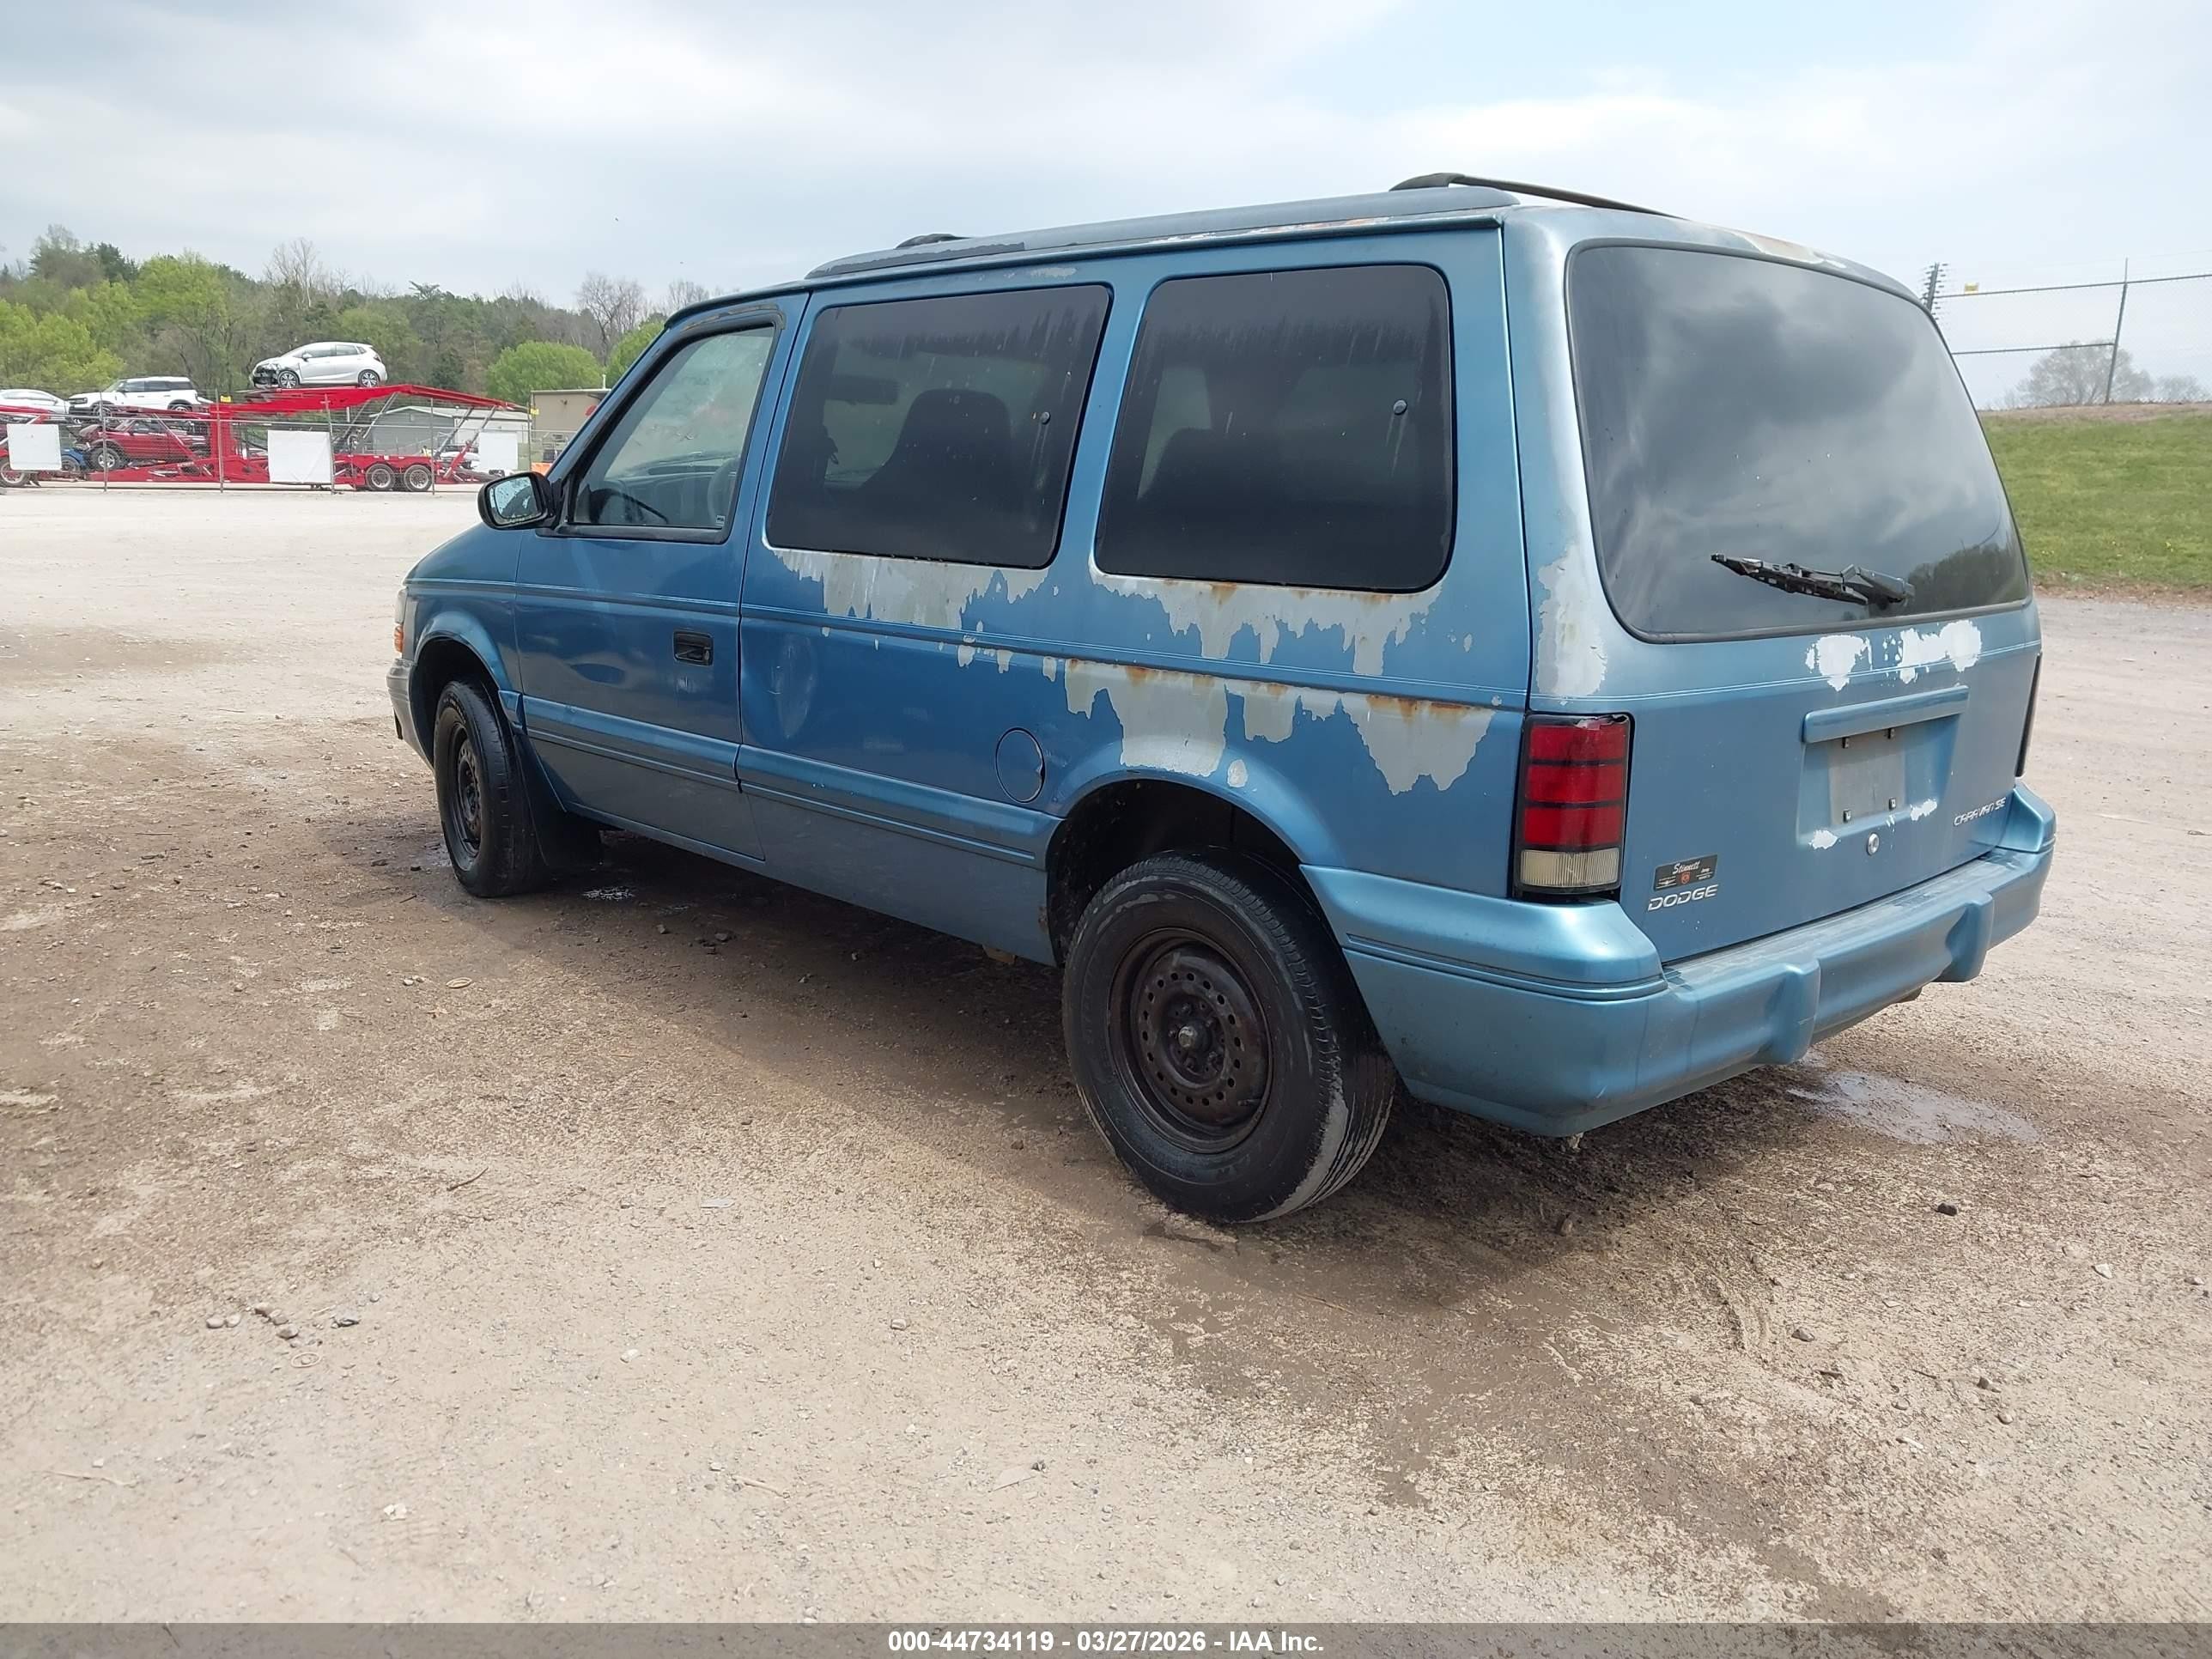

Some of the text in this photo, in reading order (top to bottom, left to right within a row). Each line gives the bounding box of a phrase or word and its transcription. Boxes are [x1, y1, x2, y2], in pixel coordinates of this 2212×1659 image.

[1954, 797, 2007, 826] CARAVAN SE
[1647, 884, 1719, 911] DODGE
